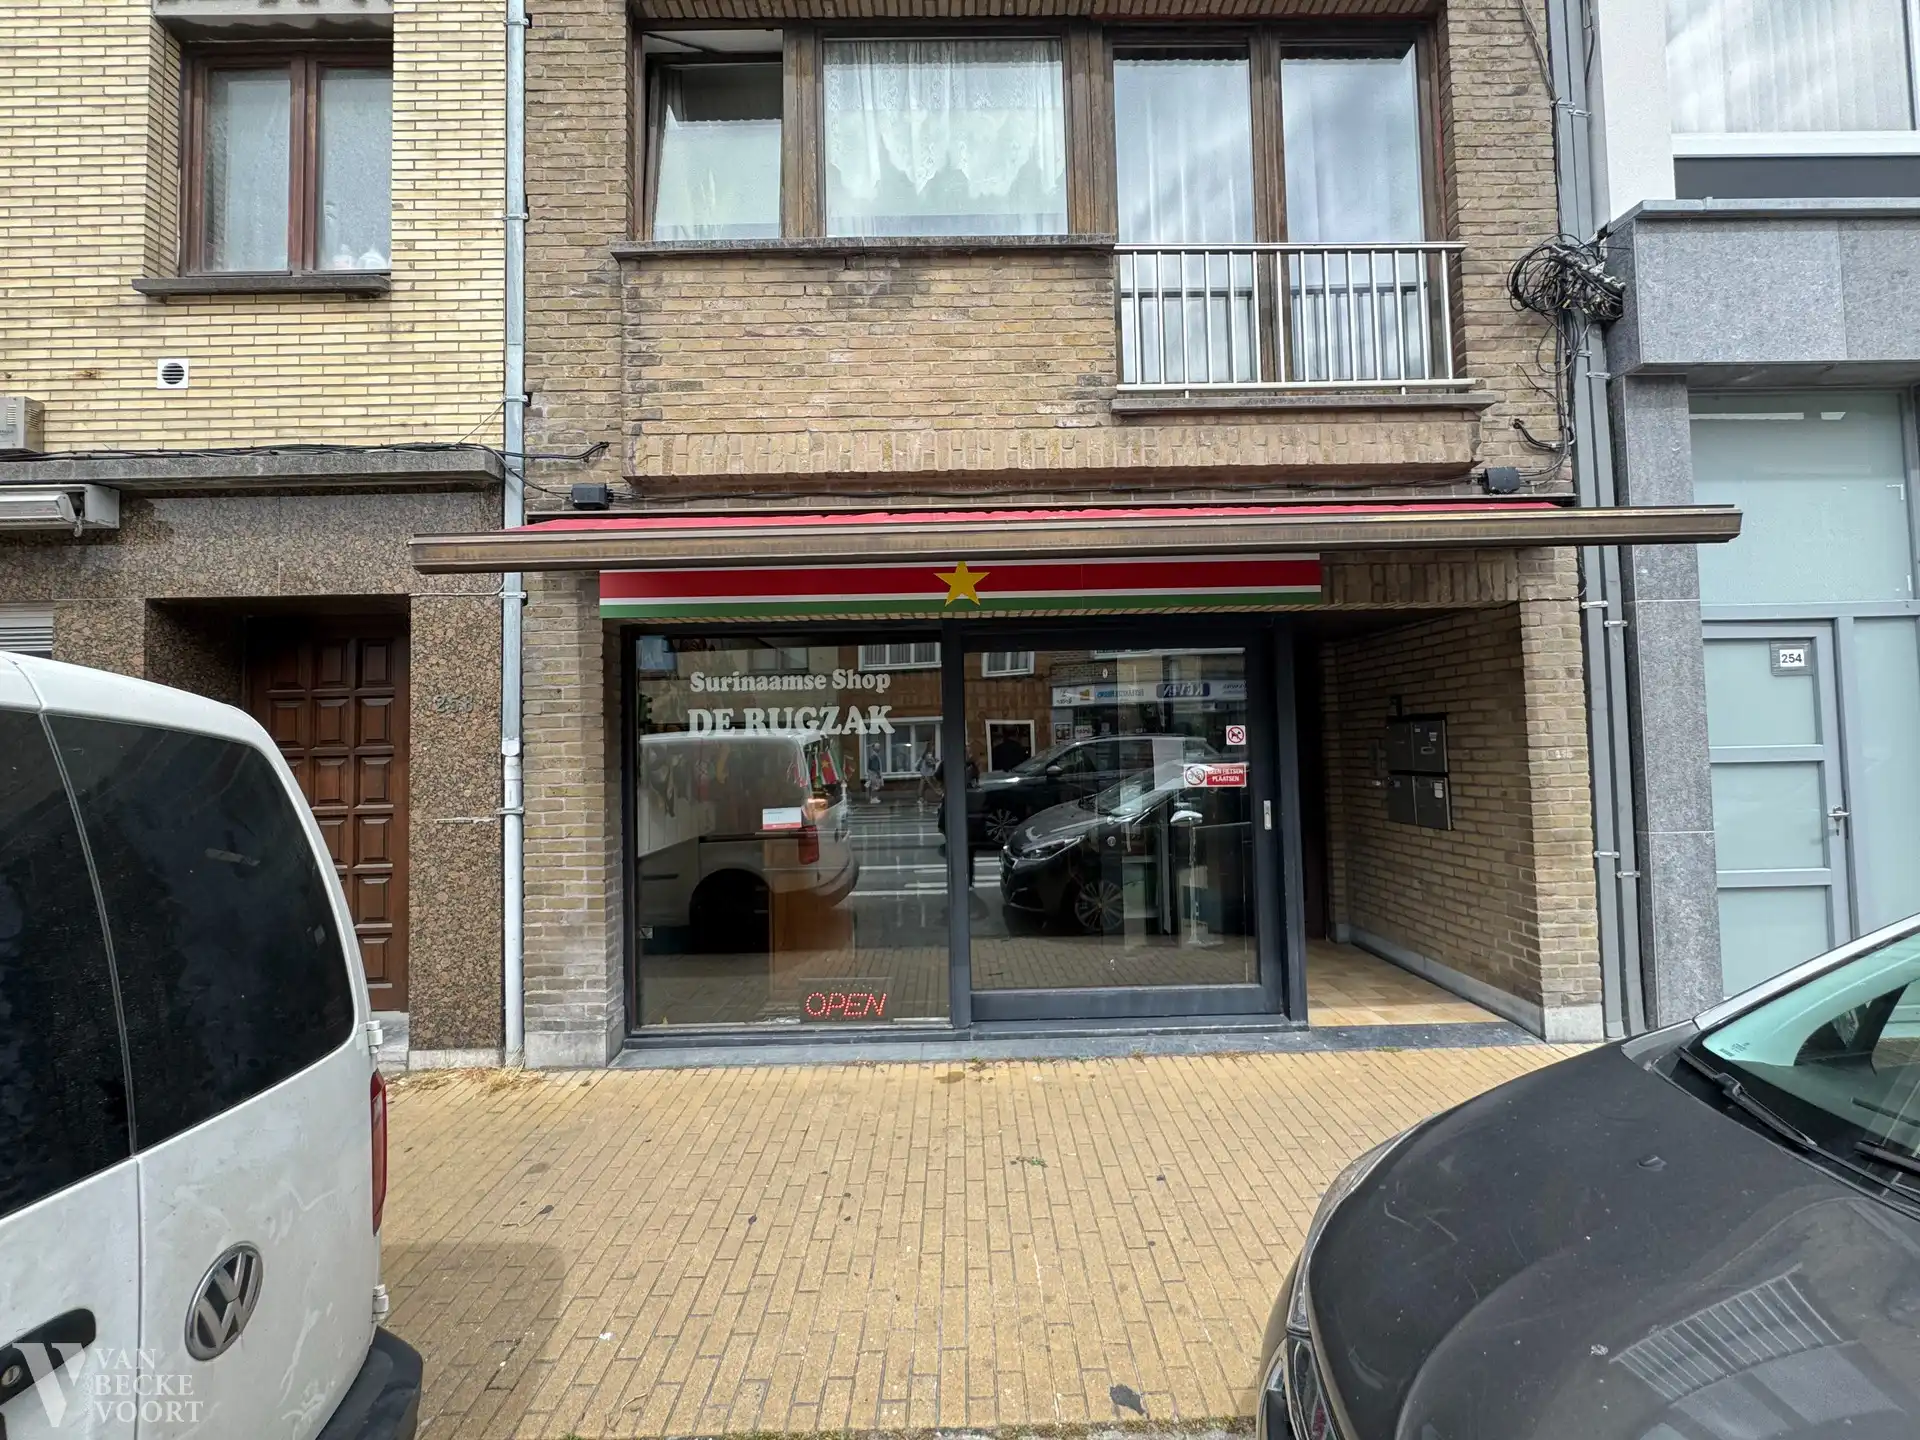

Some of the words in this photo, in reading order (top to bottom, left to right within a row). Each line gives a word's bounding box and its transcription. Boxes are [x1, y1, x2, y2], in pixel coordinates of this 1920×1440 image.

[1781, 653, 1802, 663] 254
[690, 671, 827, 692] Surinaamse
[832, 668, 891, 693] Shop
[687, 708, 735, 736] DE
[743, 705, 895, 735] RUGZAK
[804, 992, 887, 1016] OPEN
